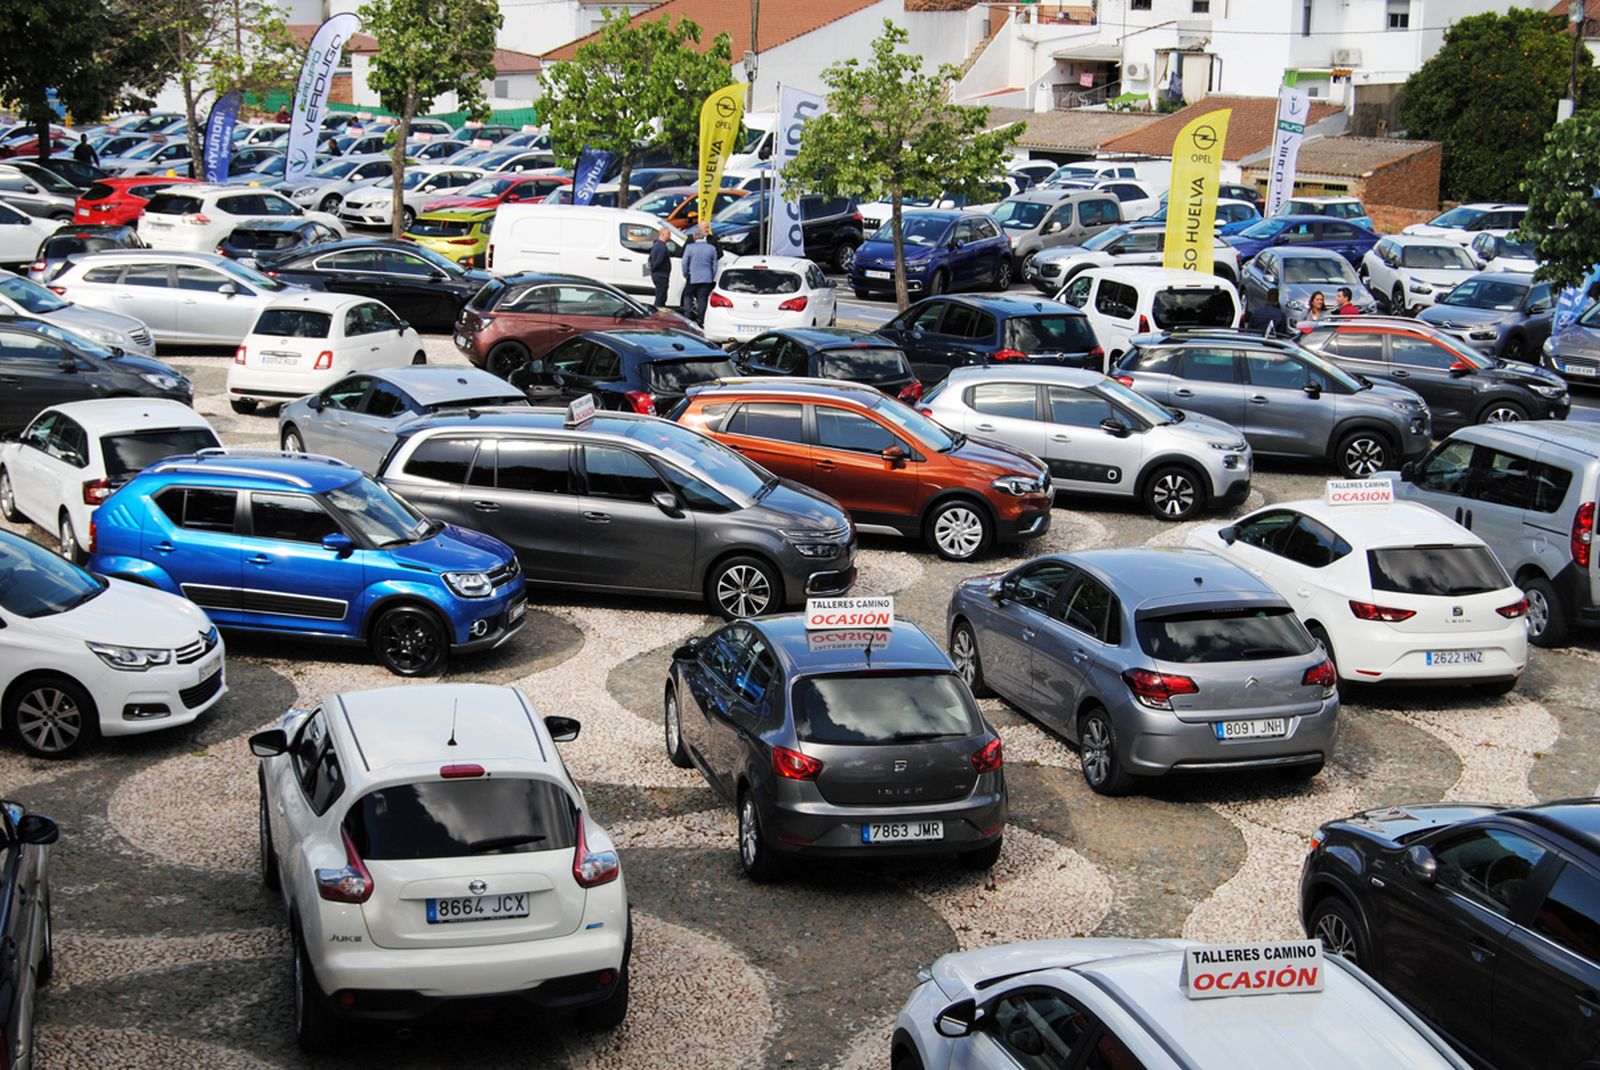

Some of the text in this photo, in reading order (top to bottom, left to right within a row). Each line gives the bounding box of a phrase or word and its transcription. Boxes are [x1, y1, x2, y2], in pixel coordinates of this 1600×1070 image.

[302, 34, 341, 136] VERDUGO
[208, 111, 225, 169] HYUNDAI
[703, 139, 724, 197] HUELVA
[1191, 154, 1213, 164] OPEL
[577, 159, 606, 202] Syrluz
[1185, 176, 1205, 243] HUELVA
[811, 599, 890, 609] TALLERES CAMINO
[1433, 651, 1483, 664] 2622 HNZ
[1226, 721, 1282, 736] 8091 JNH
[873, 822, 940, 839] 7863 JMR
[439, 895, 525, 917] 8664 JCX
[1192, 945, 1316, 964] TALLERES CAMINO
[1193, 964, 1318, 991] OCASIÓN
